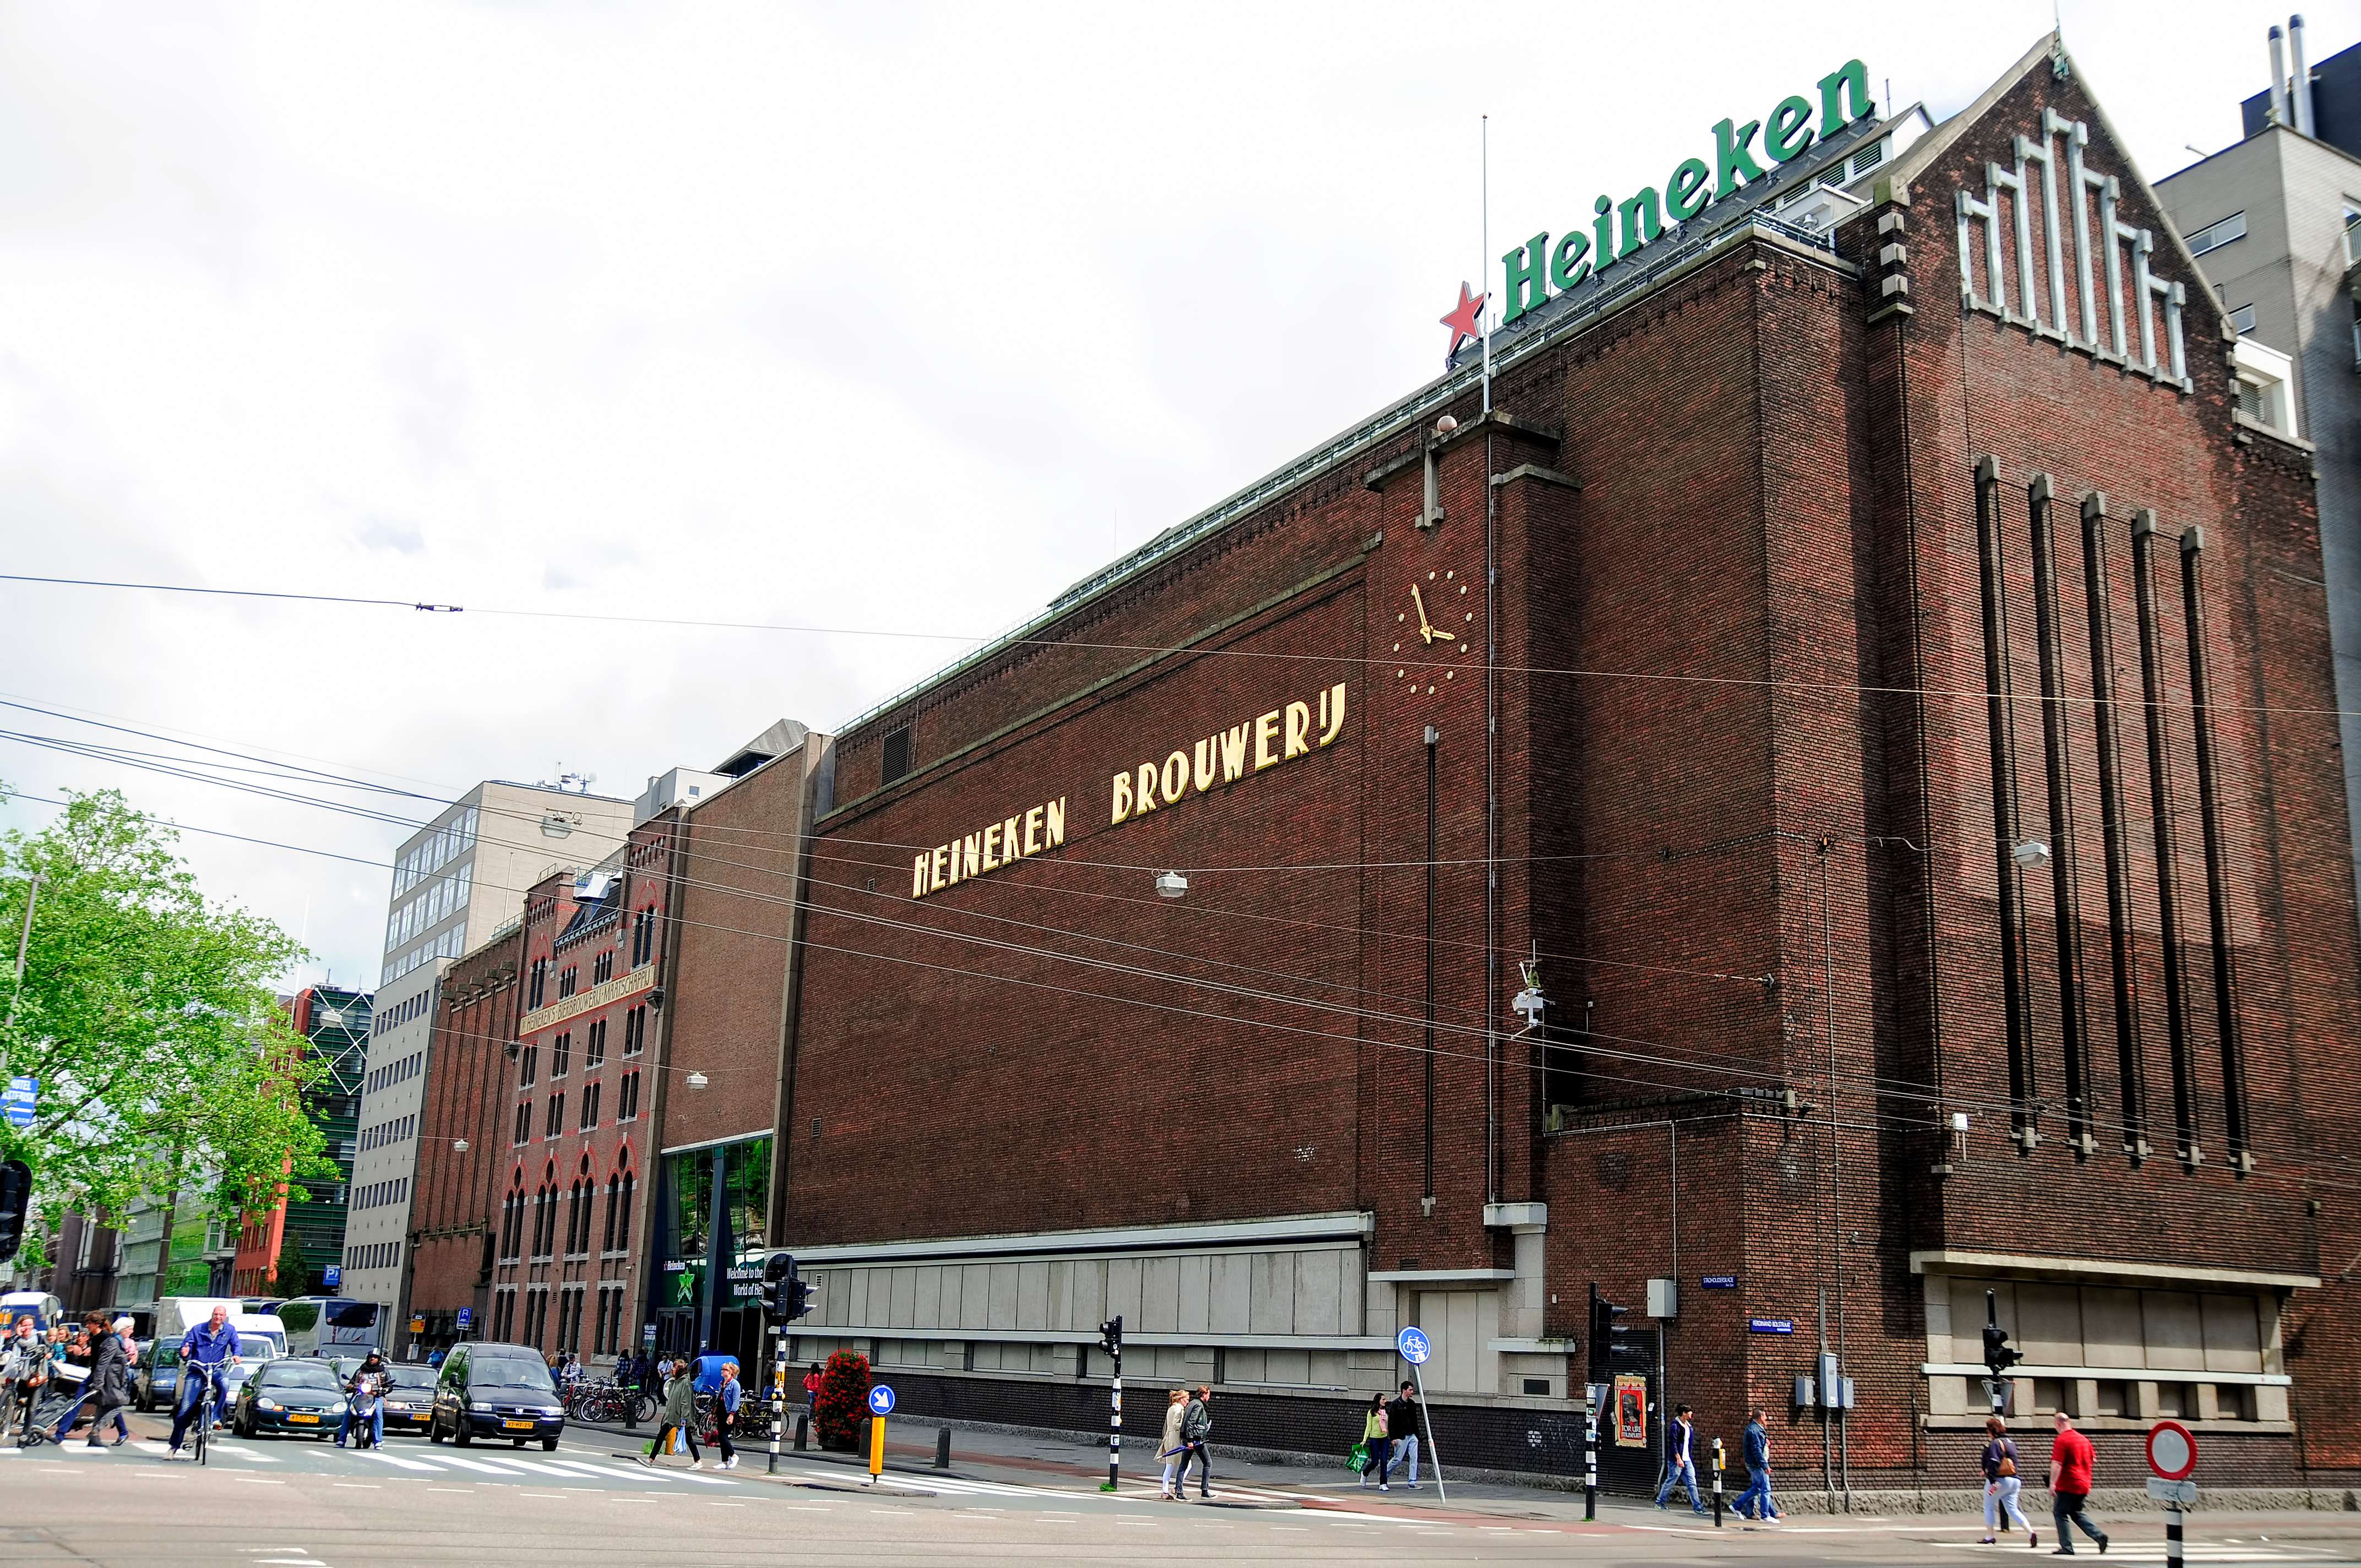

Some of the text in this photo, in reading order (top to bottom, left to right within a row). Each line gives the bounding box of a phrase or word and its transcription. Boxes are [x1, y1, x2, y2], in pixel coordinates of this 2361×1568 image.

[1502, 59, 1875, 325] Heineken
[912, 682, 1346, 899] HEINEKEN BROUWERIJ
[557, 990, 602, 1020] BIERBROUWERIJ
[603, 970, 650, 1001] MAATSCHAPPIJ
[326, 1268, 335, 1278] P
[727, 1266, 763, 1279] Welcome to the
[733, 1283, 748, 1295] World
[748, 1283, 754, 1295] of
